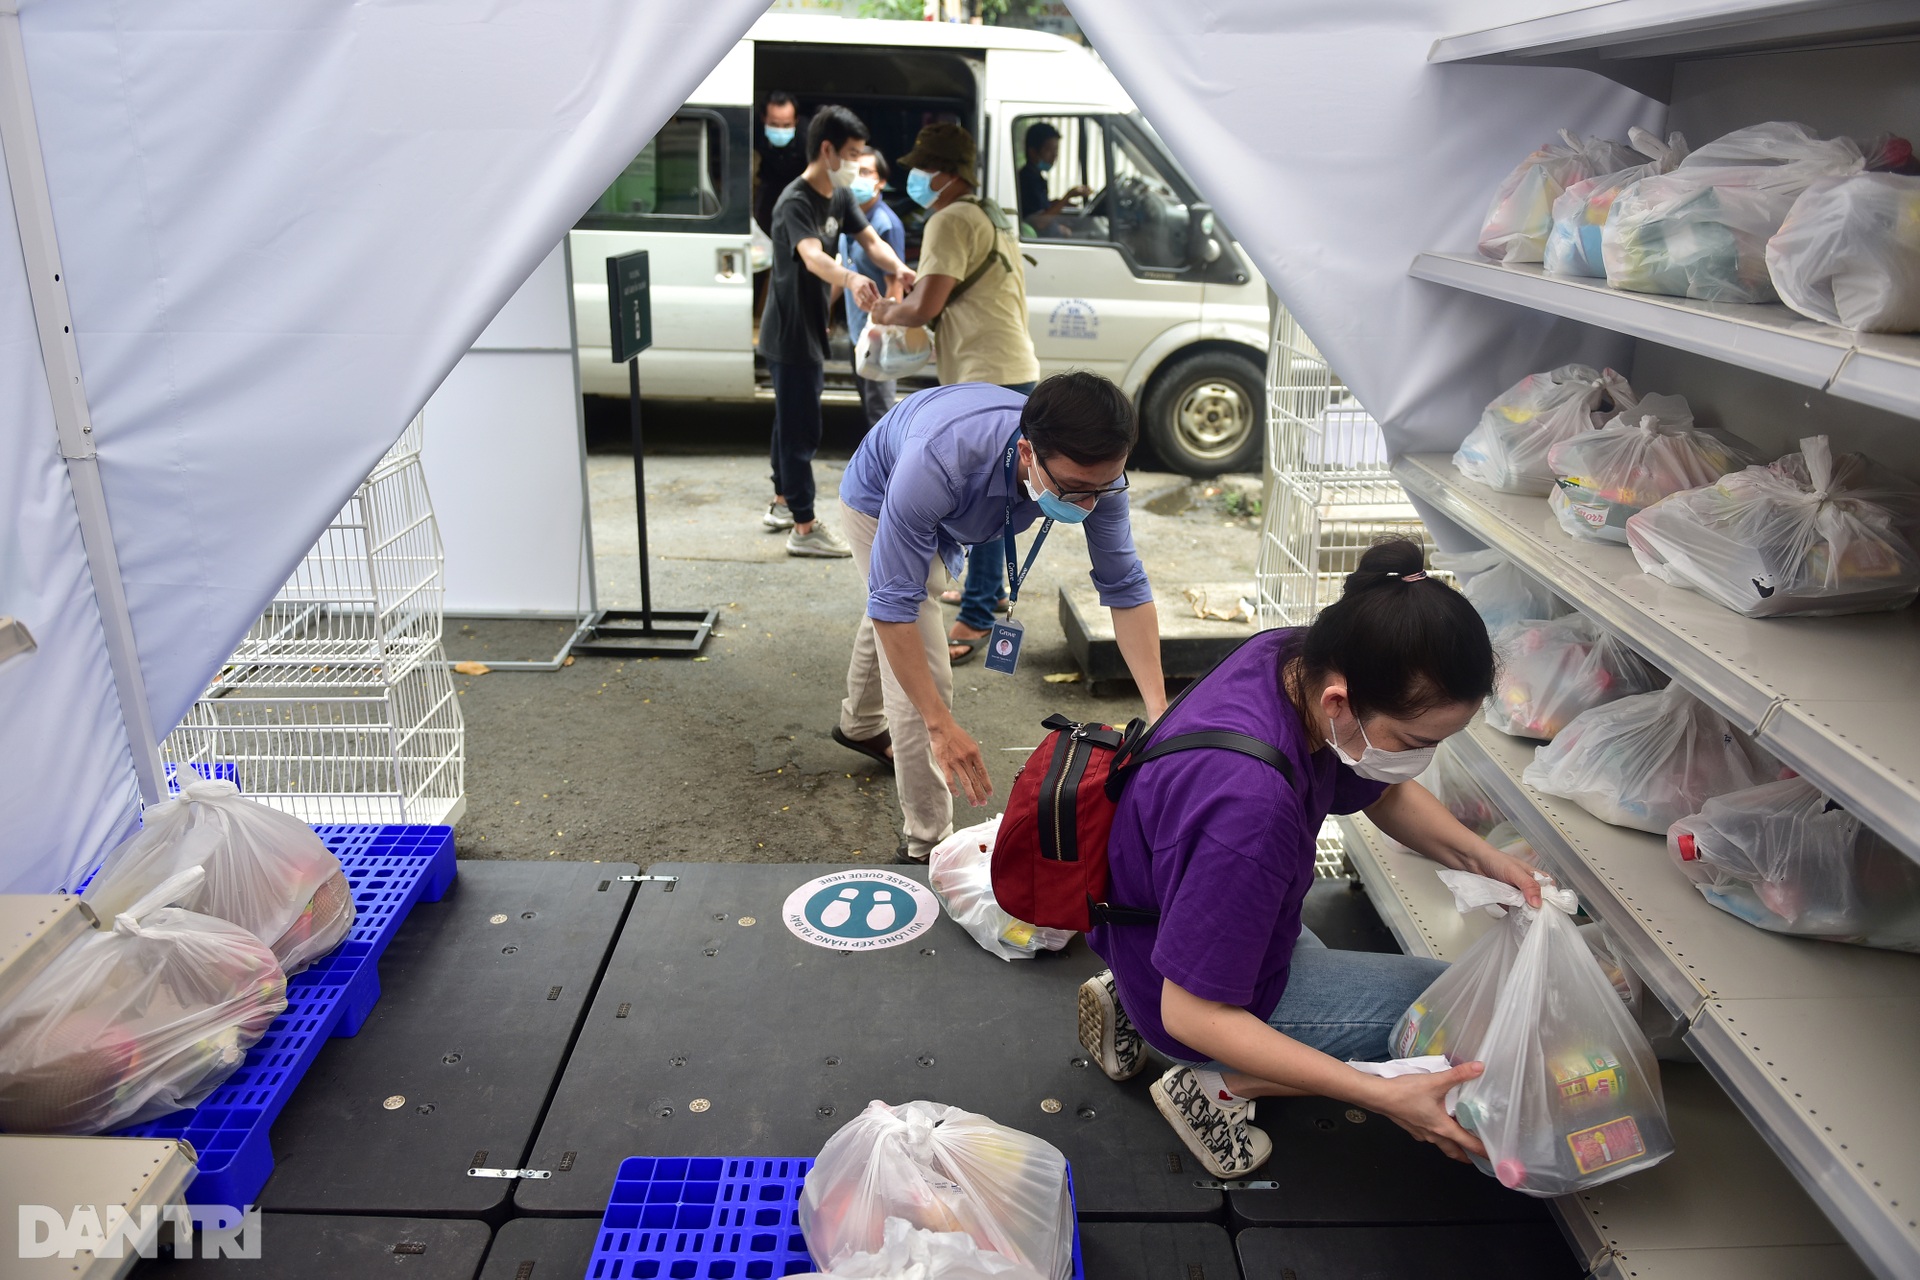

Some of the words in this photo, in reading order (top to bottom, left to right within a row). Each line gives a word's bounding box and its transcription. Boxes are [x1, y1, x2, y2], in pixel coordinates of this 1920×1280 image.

[1005, 447, 1014, 468] Grove
[999, 628, 1017, 638] Grove
[818, 875, 846, 885] HERE
[885, 875, 920, 893] PLEASE
[790, 914, 804, 927] ĐÂY
[799, 926, 814, 938] TẠI
[907, 922, 924, 933] VUI
[814, 935, 848, 946] HÀNG
[878, 932, 909, 944] LÒNG
[851, 940, 876, 949] XẾP
